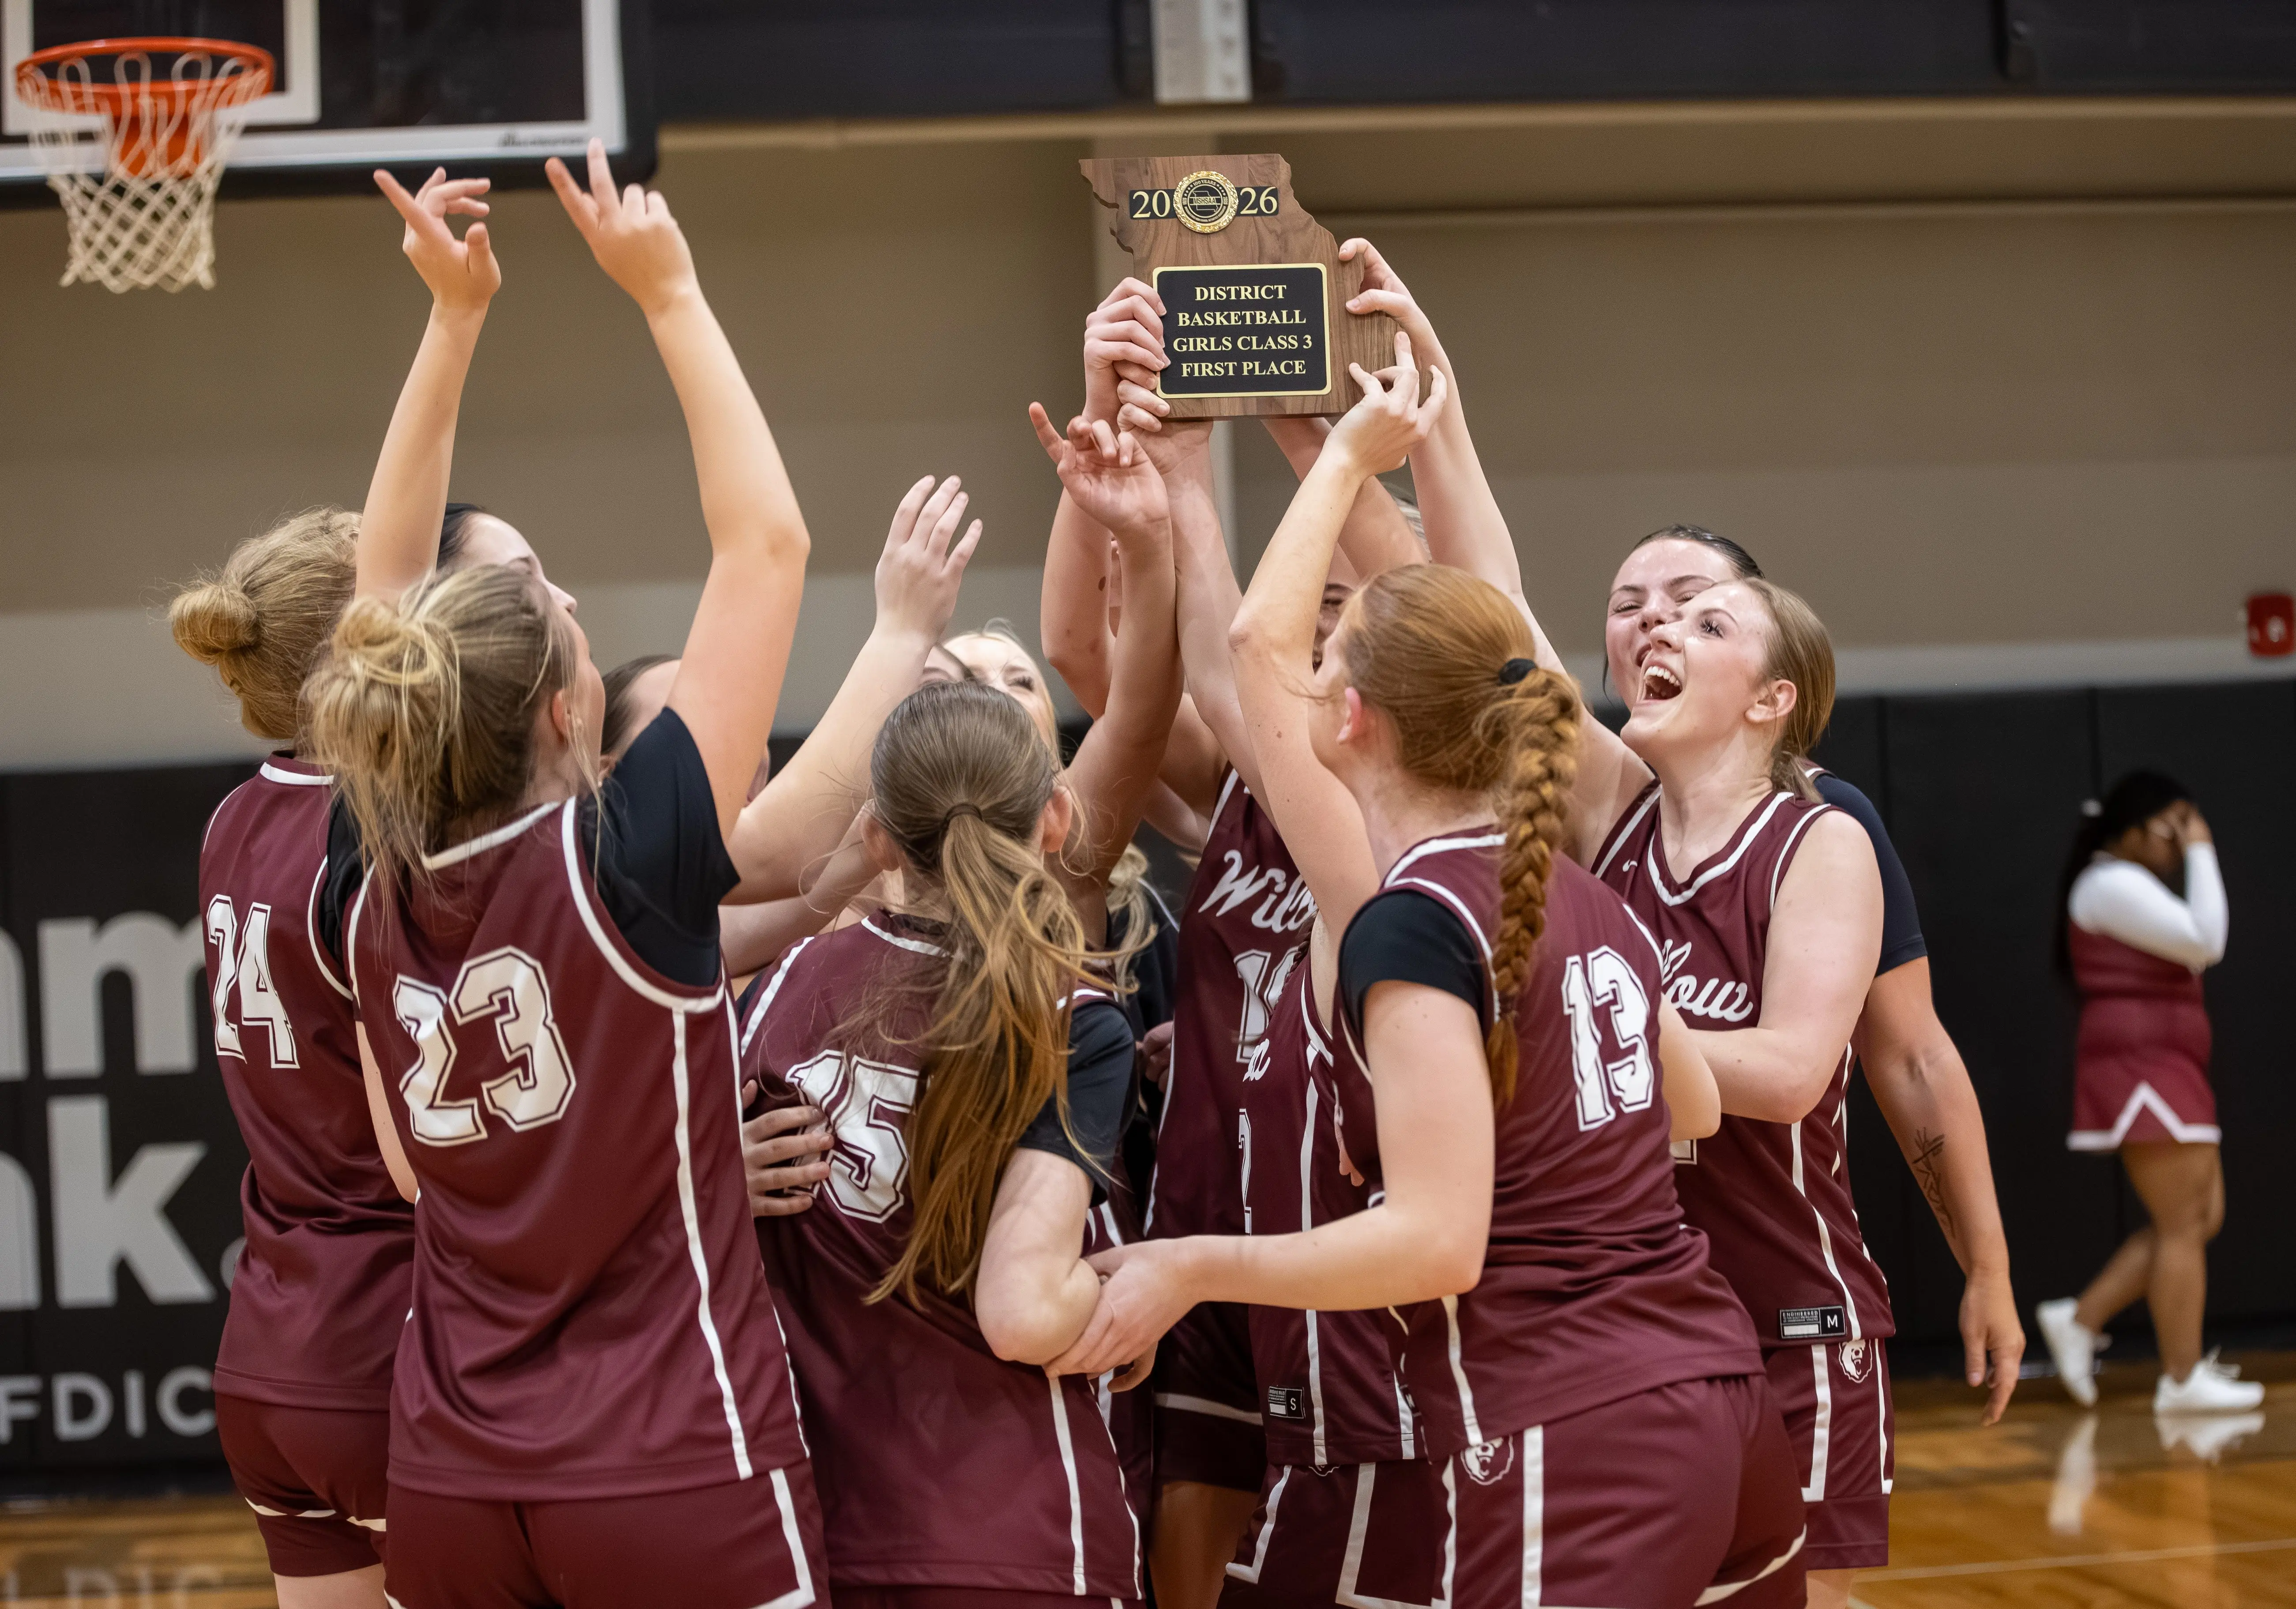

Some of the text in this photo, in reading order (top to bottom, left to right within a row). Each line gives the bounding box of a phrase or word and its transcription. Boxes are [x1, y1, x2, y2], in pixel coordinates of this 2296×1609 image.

[1132, 191, 1171, 218] 20
[1239, 187, 1277, 215] 26
[1194, 285, 1287, 301] DISTRICT
[1177, 310, 1306, 327] BASKETBALL
[1173, 335, 1312, 352] GIRLS CLASS 3
[1181, 360, 1306, 377] FIRST PLACE
[207, 894, 300, 1069] 24
[392, 945, 576, 1147] 23
[1561, 945, 1655, 1131] 13
[1827, 1314, 1838, 1328] M
[0, 1365, 215, 1444] FDIC
[1290, 1398, 1296, 1411] S
